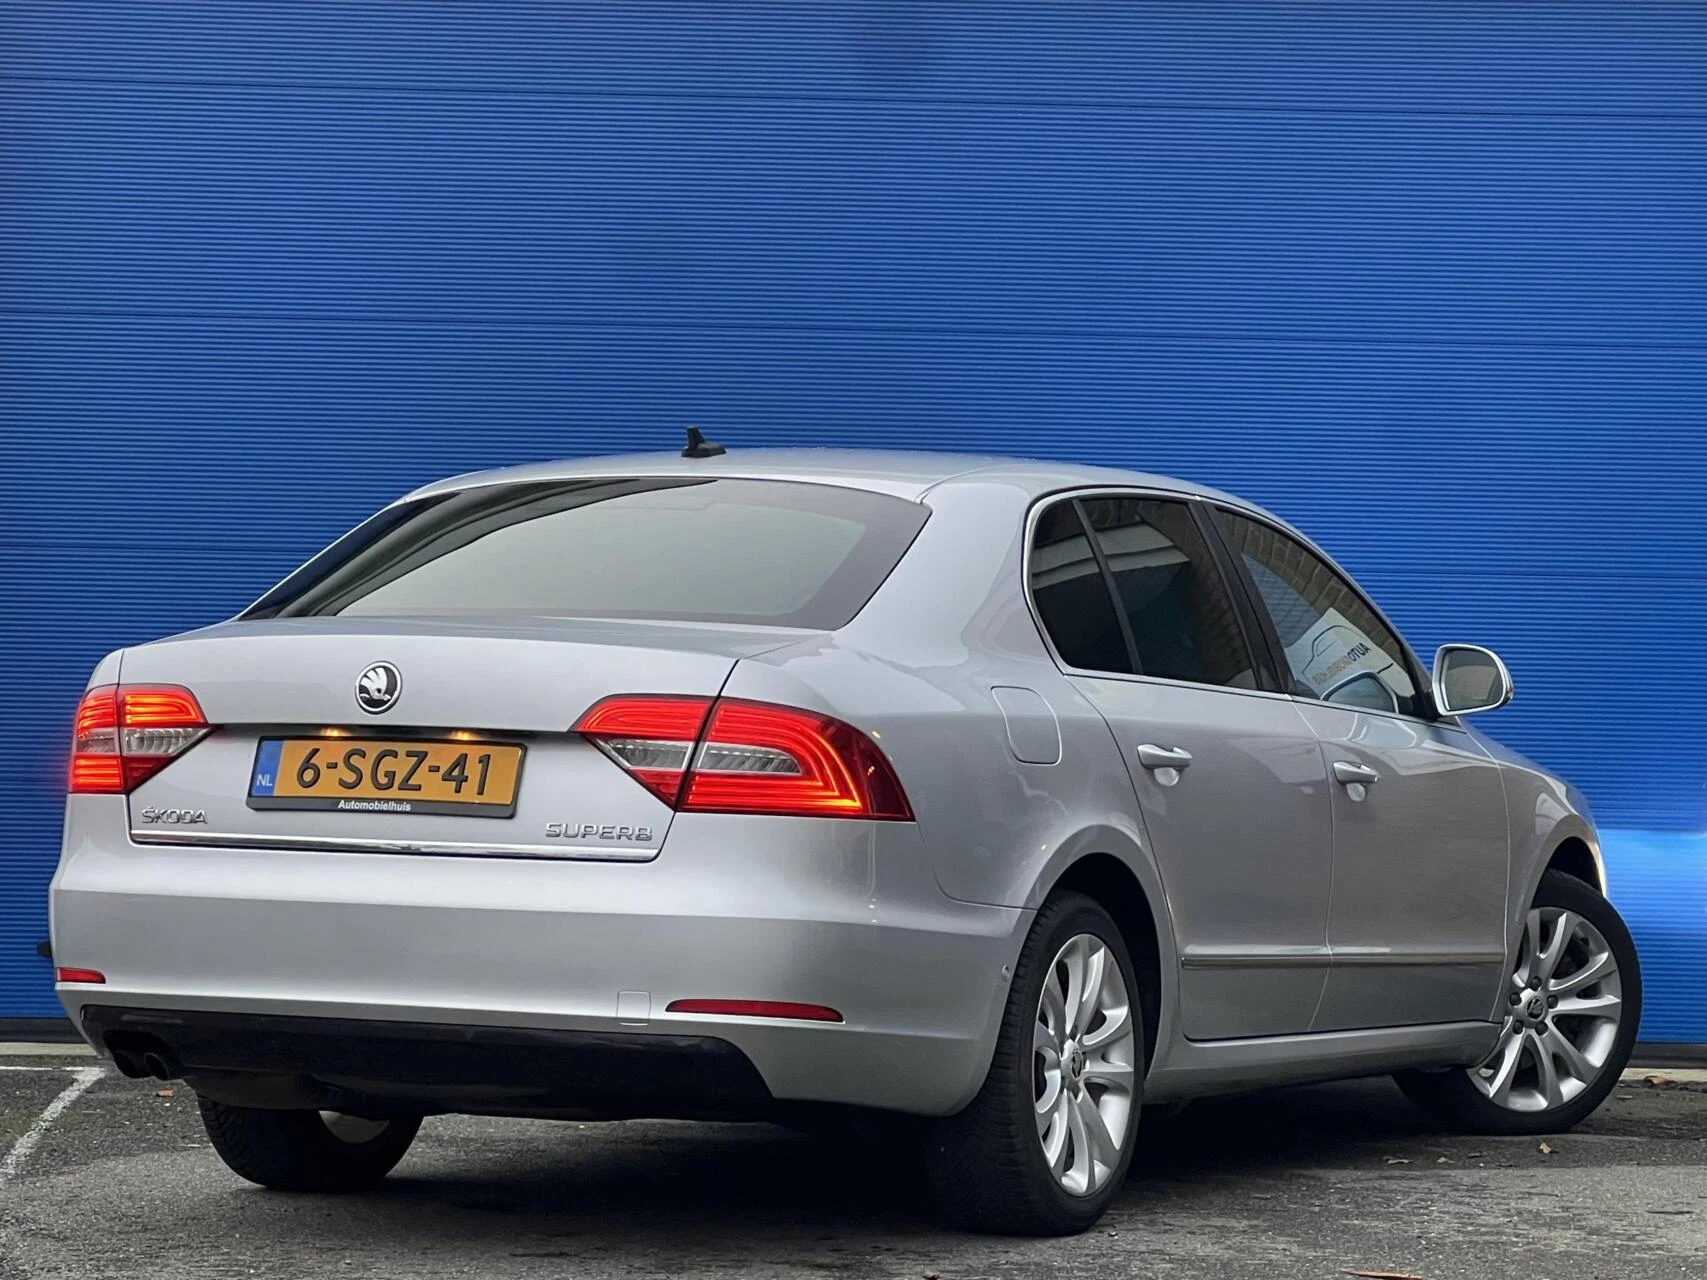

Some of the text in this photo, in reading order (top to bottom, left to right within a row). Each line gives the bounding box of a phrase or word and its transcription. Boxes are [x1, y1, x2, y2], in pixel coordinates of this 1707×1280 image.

[256, 773, 273, 786] NL
[296, 748, 491, 796] 6-SGZ-41
[338, 800, 411, 811] Automobielhuis
[545, 822, 653, 841] SUPERB
